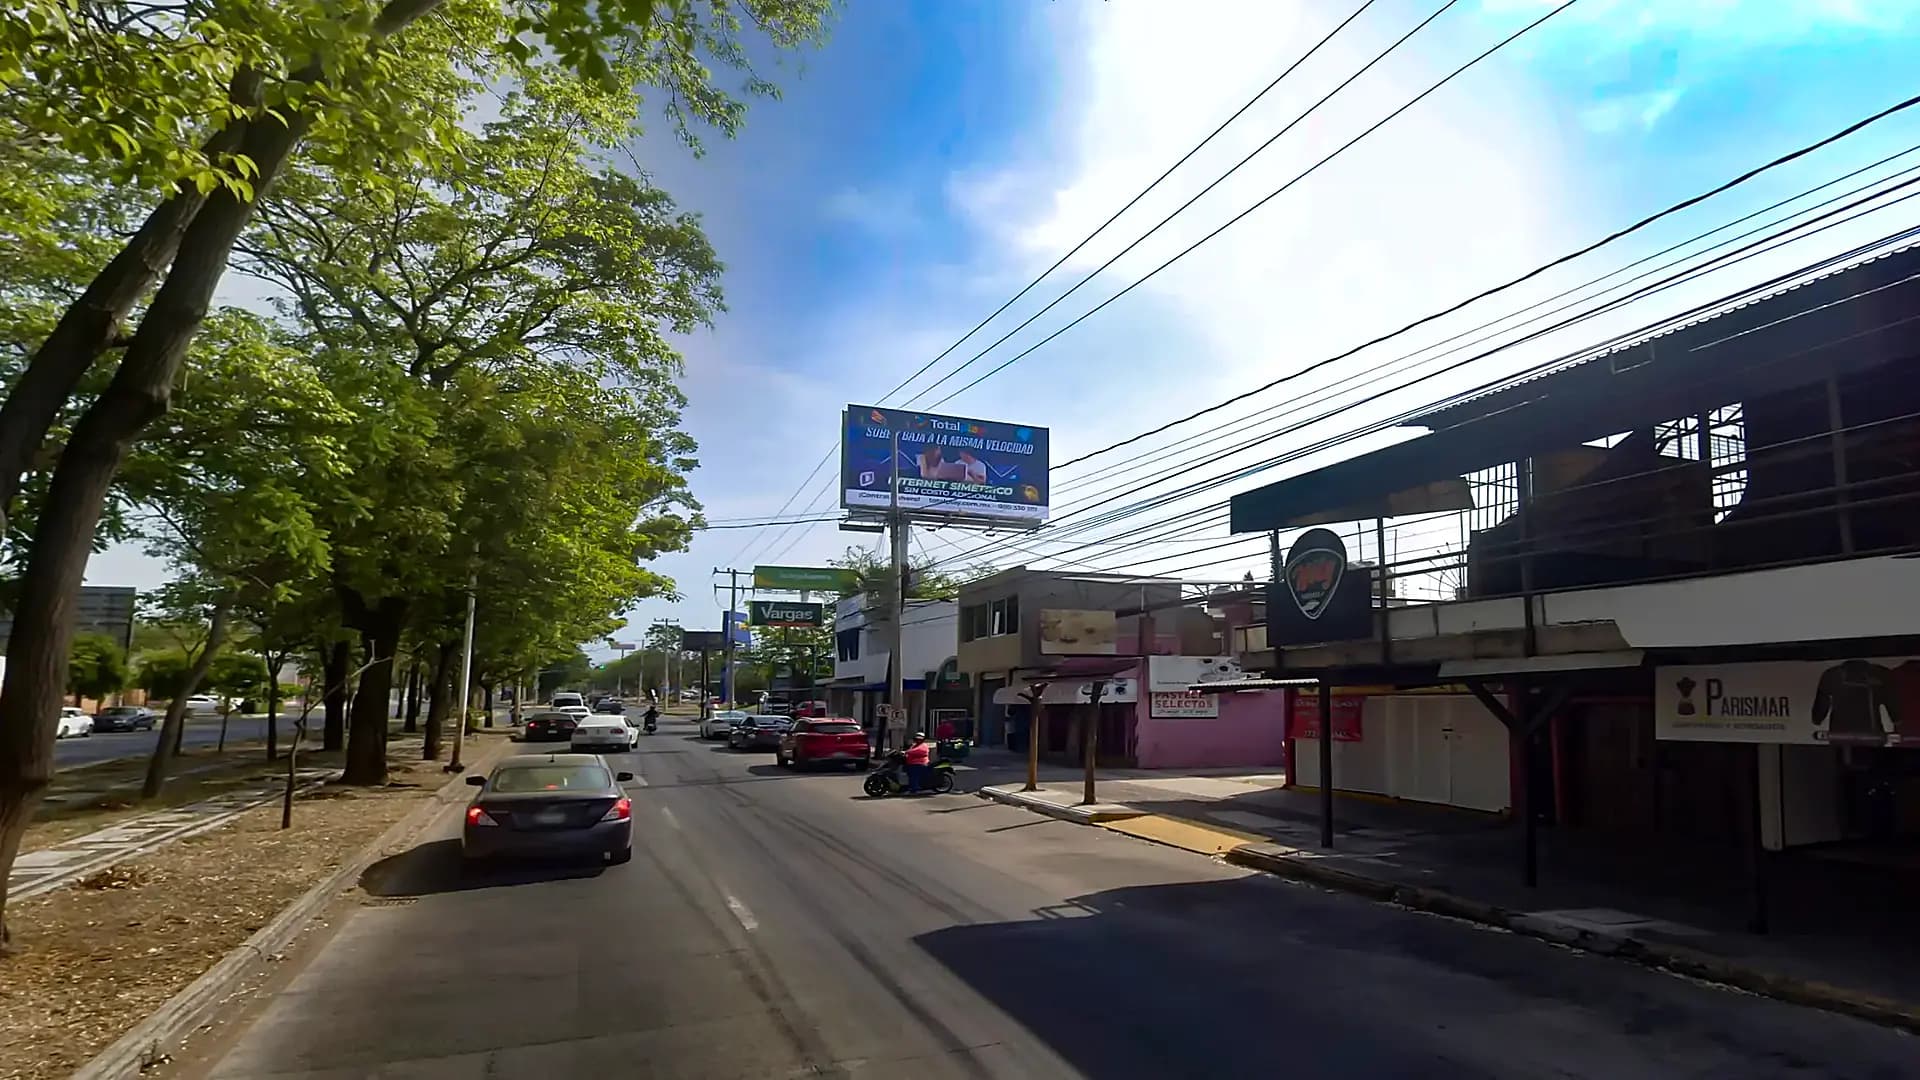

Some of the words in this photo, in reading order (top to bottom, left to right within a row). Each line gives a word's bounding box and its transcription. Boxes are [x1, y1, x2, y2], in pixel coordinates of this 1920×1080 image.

[902, 431, 926, 443] BAJA
[927, 433, 935, 443] A
[936, 434, 947, 446] LA
[949, 436, 983, 449] MISMA
[985, 440, 1033, 455] VELOCIDAD
[904, 487, 919, 495] SIN
[921, 488, 950, 497] COSTO
[761, 603, 813, 621] Vargas
